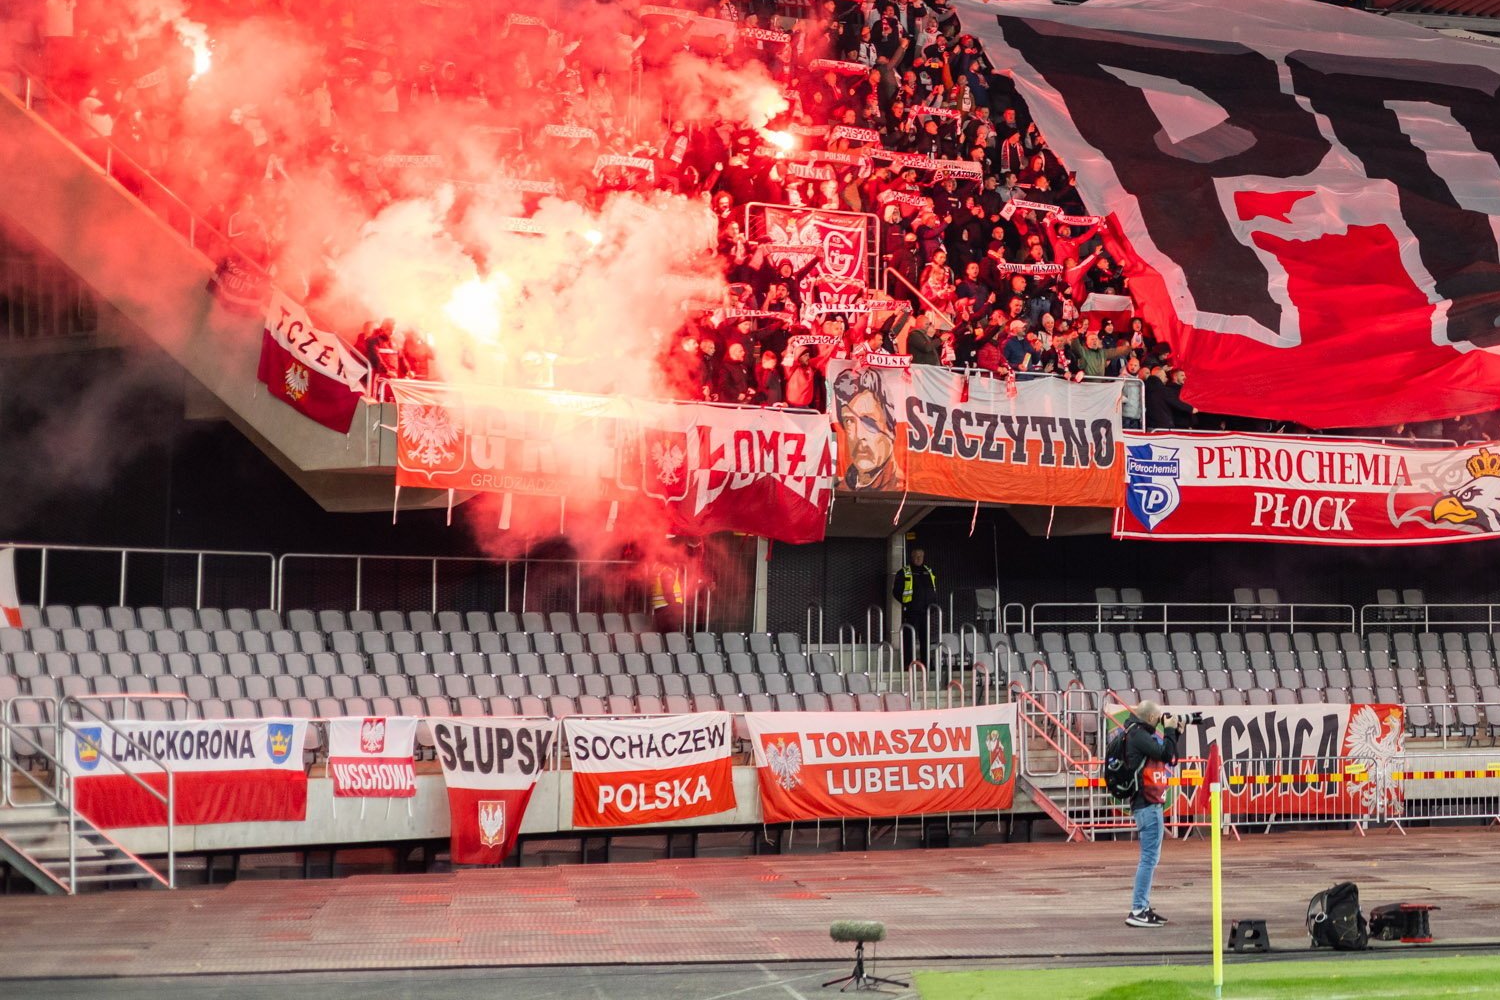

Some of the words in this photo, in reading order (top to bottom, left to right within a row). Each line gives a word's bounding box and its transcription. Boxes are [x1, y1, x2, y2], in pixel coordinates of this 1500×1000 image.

[869, 355, 909, 366] POLSK
[904, 395, 1116, 470] SZCZYTNO
[1195, 446, 1412, 486] PETROCHEMIA
[1251, 491, 1356, 532] PŁOCK
[111, 728, 256, 763] LANCKORONA
[435, 723, 553, 776] SŁUPSK
[574, 720, 728, 762] SOCHACZEW
[805, 721, 972, 759] TOMASZÓW
[334, 761, 416, 792] WSCHOWA
[597, 774, 713, 815] POLSKA
[826, 762, 966, 795] LUBELSKI
